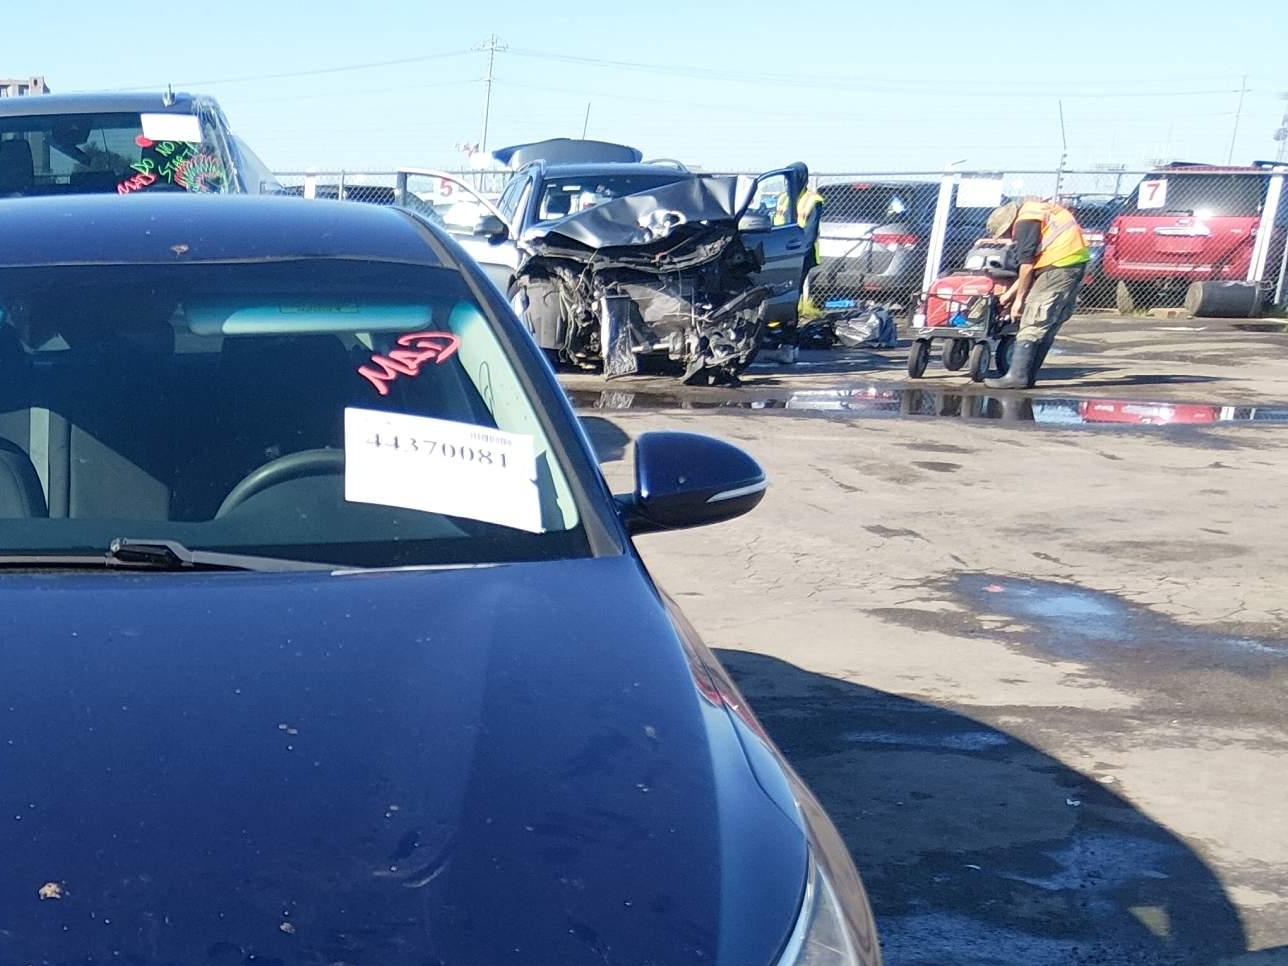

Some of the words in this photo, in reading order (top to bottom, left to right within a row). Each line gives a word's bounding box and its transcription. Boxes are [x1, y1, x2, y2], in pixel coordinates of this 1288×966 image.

[440, 178, 453, 198] 5
[1148, 184, 1160, 200] 7
[358, 332, 460, 395] MAD
[366, 431, 509, 468] 44370081
